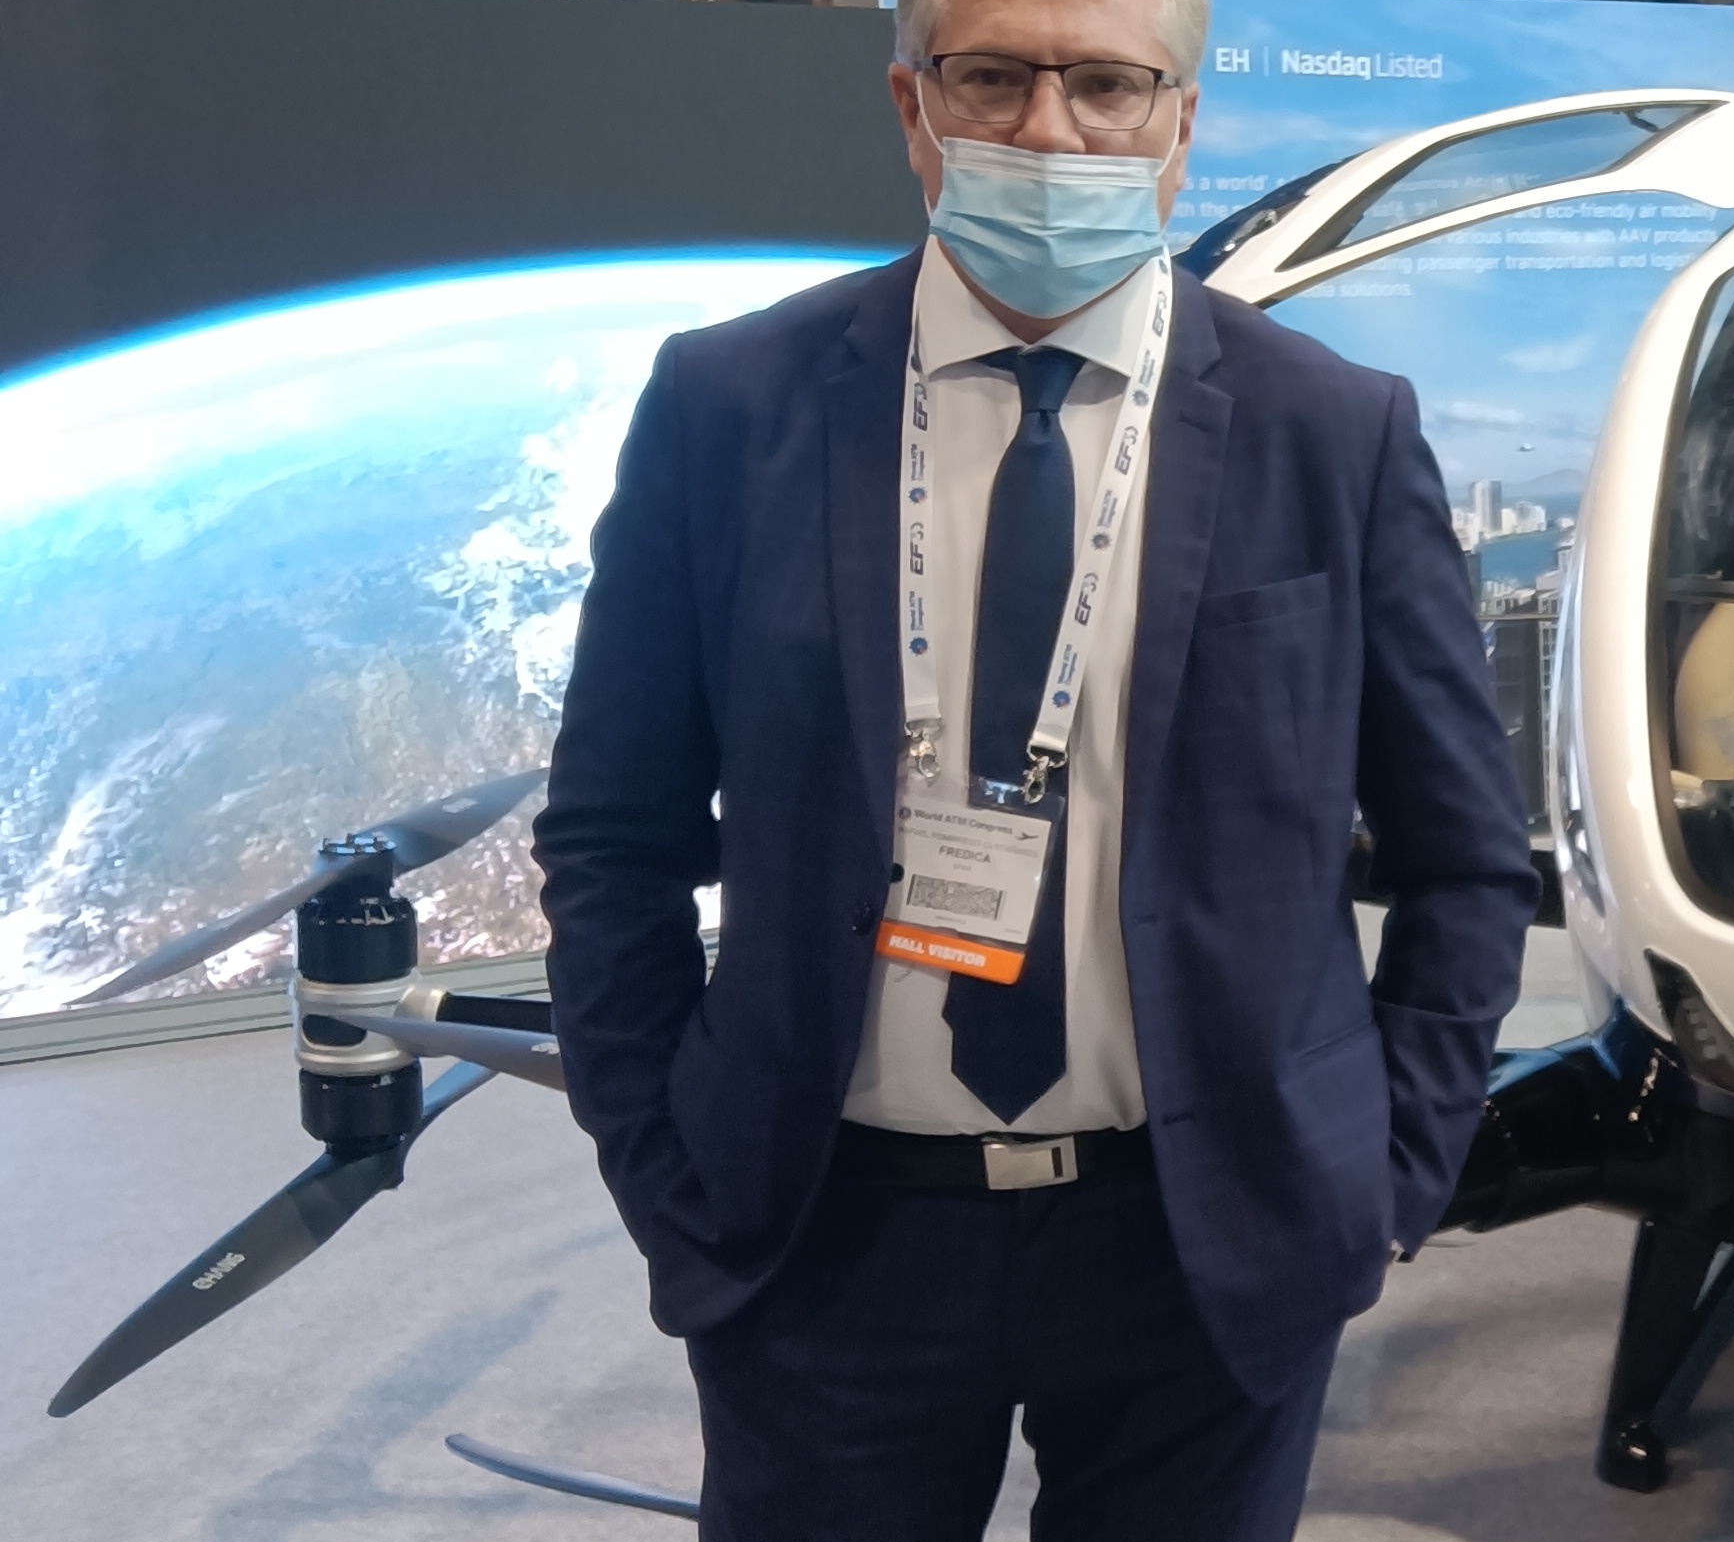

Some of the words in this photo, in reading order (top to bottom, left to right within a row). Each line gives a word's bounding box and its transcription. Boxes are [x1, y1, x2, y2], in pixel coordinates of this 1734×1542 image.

[1216, 47, 1250, 73] EH
[1281, 50, 1372, 80] Nasdaq
[1374, 52, 1443, 79] Listed
[1546, 203, 1635, 221] eco-friendly
[1639, 204, 1657, 218] air
[1619, 230, 1650, 242] AAV
[1505, 255, 1614, 271] transportation
[1618, 254, 1647, 268] and
[938, 845, 991, 863] FREDICA
